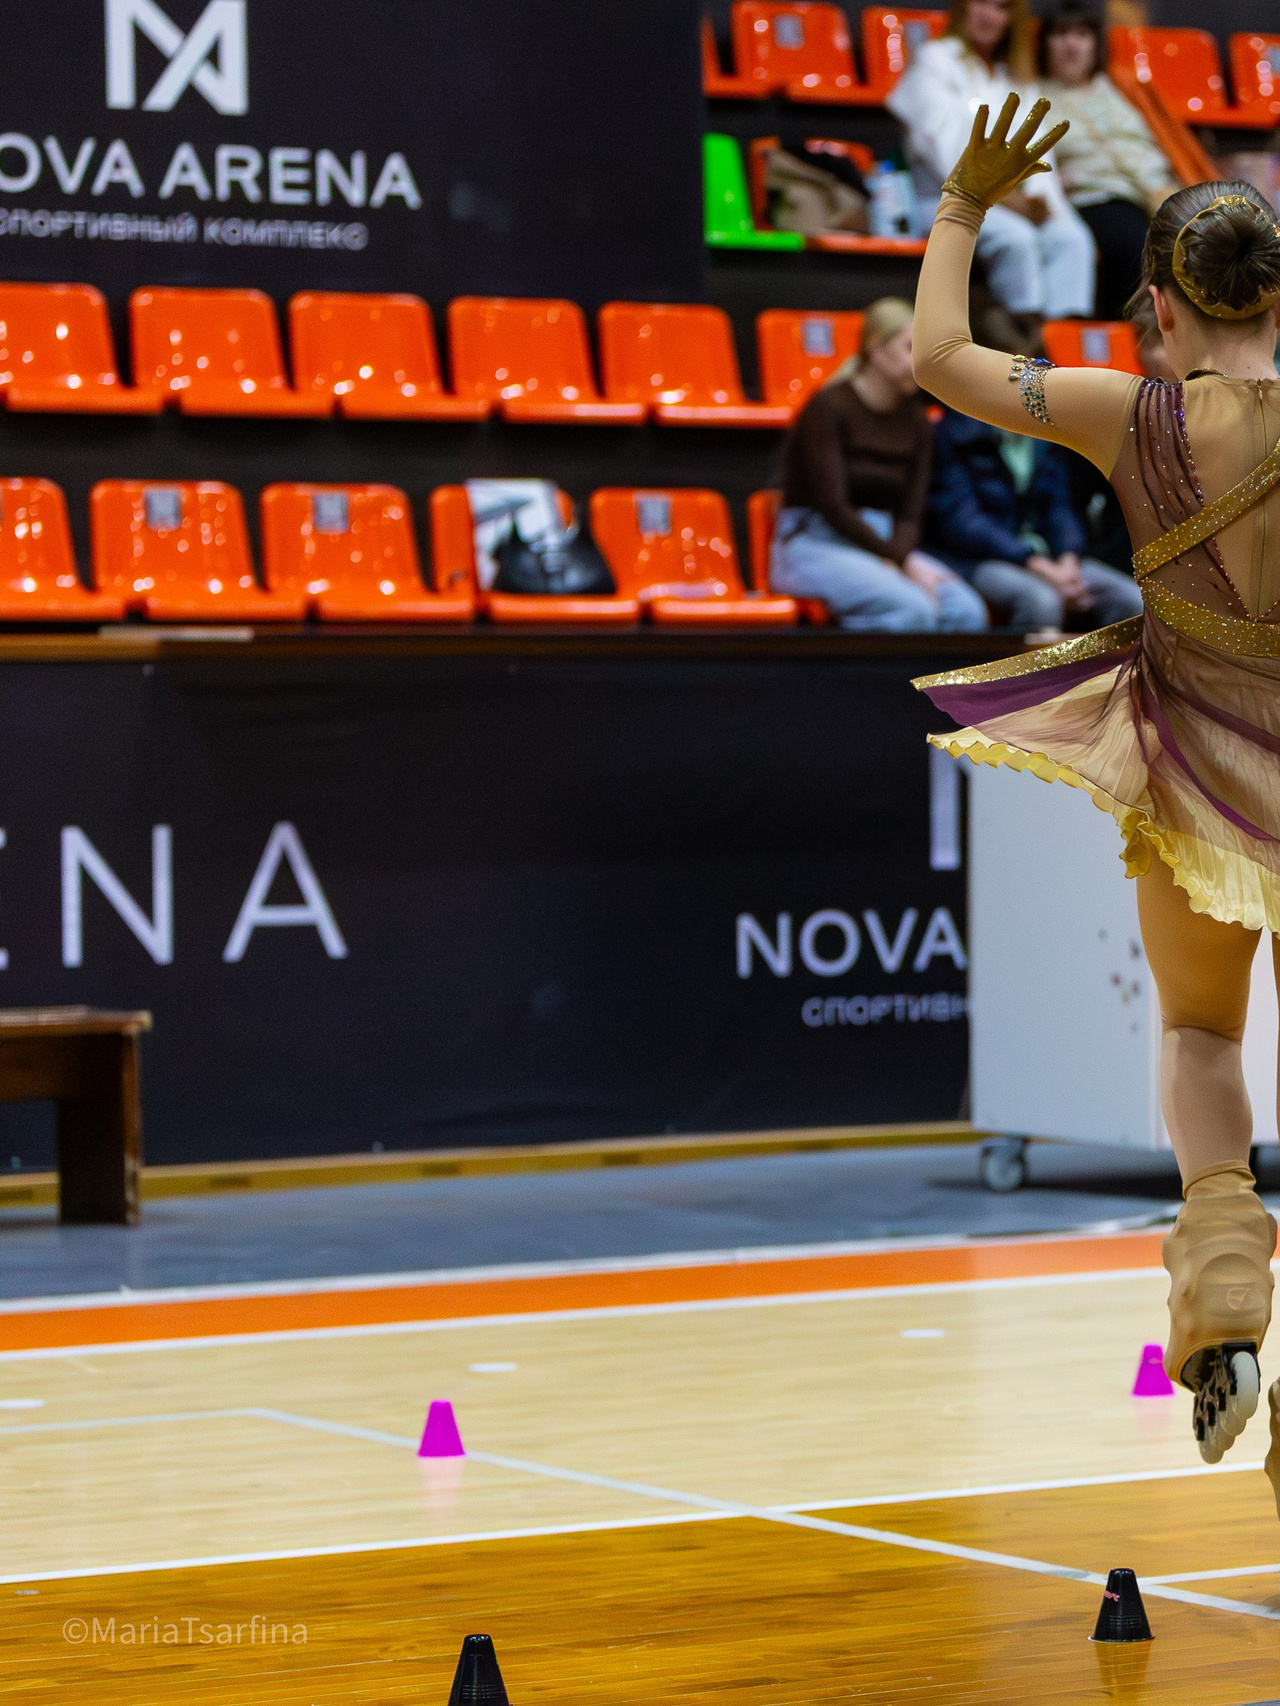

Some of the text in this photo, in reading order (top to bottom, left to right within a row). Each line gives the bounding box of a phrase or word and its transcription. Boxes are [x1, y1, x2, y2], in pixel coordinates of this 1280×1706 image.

[158, 142, 422, 210] ARENA
[0, 820, 349, 969] NA
[735, 907, 968, 979] NOVA
